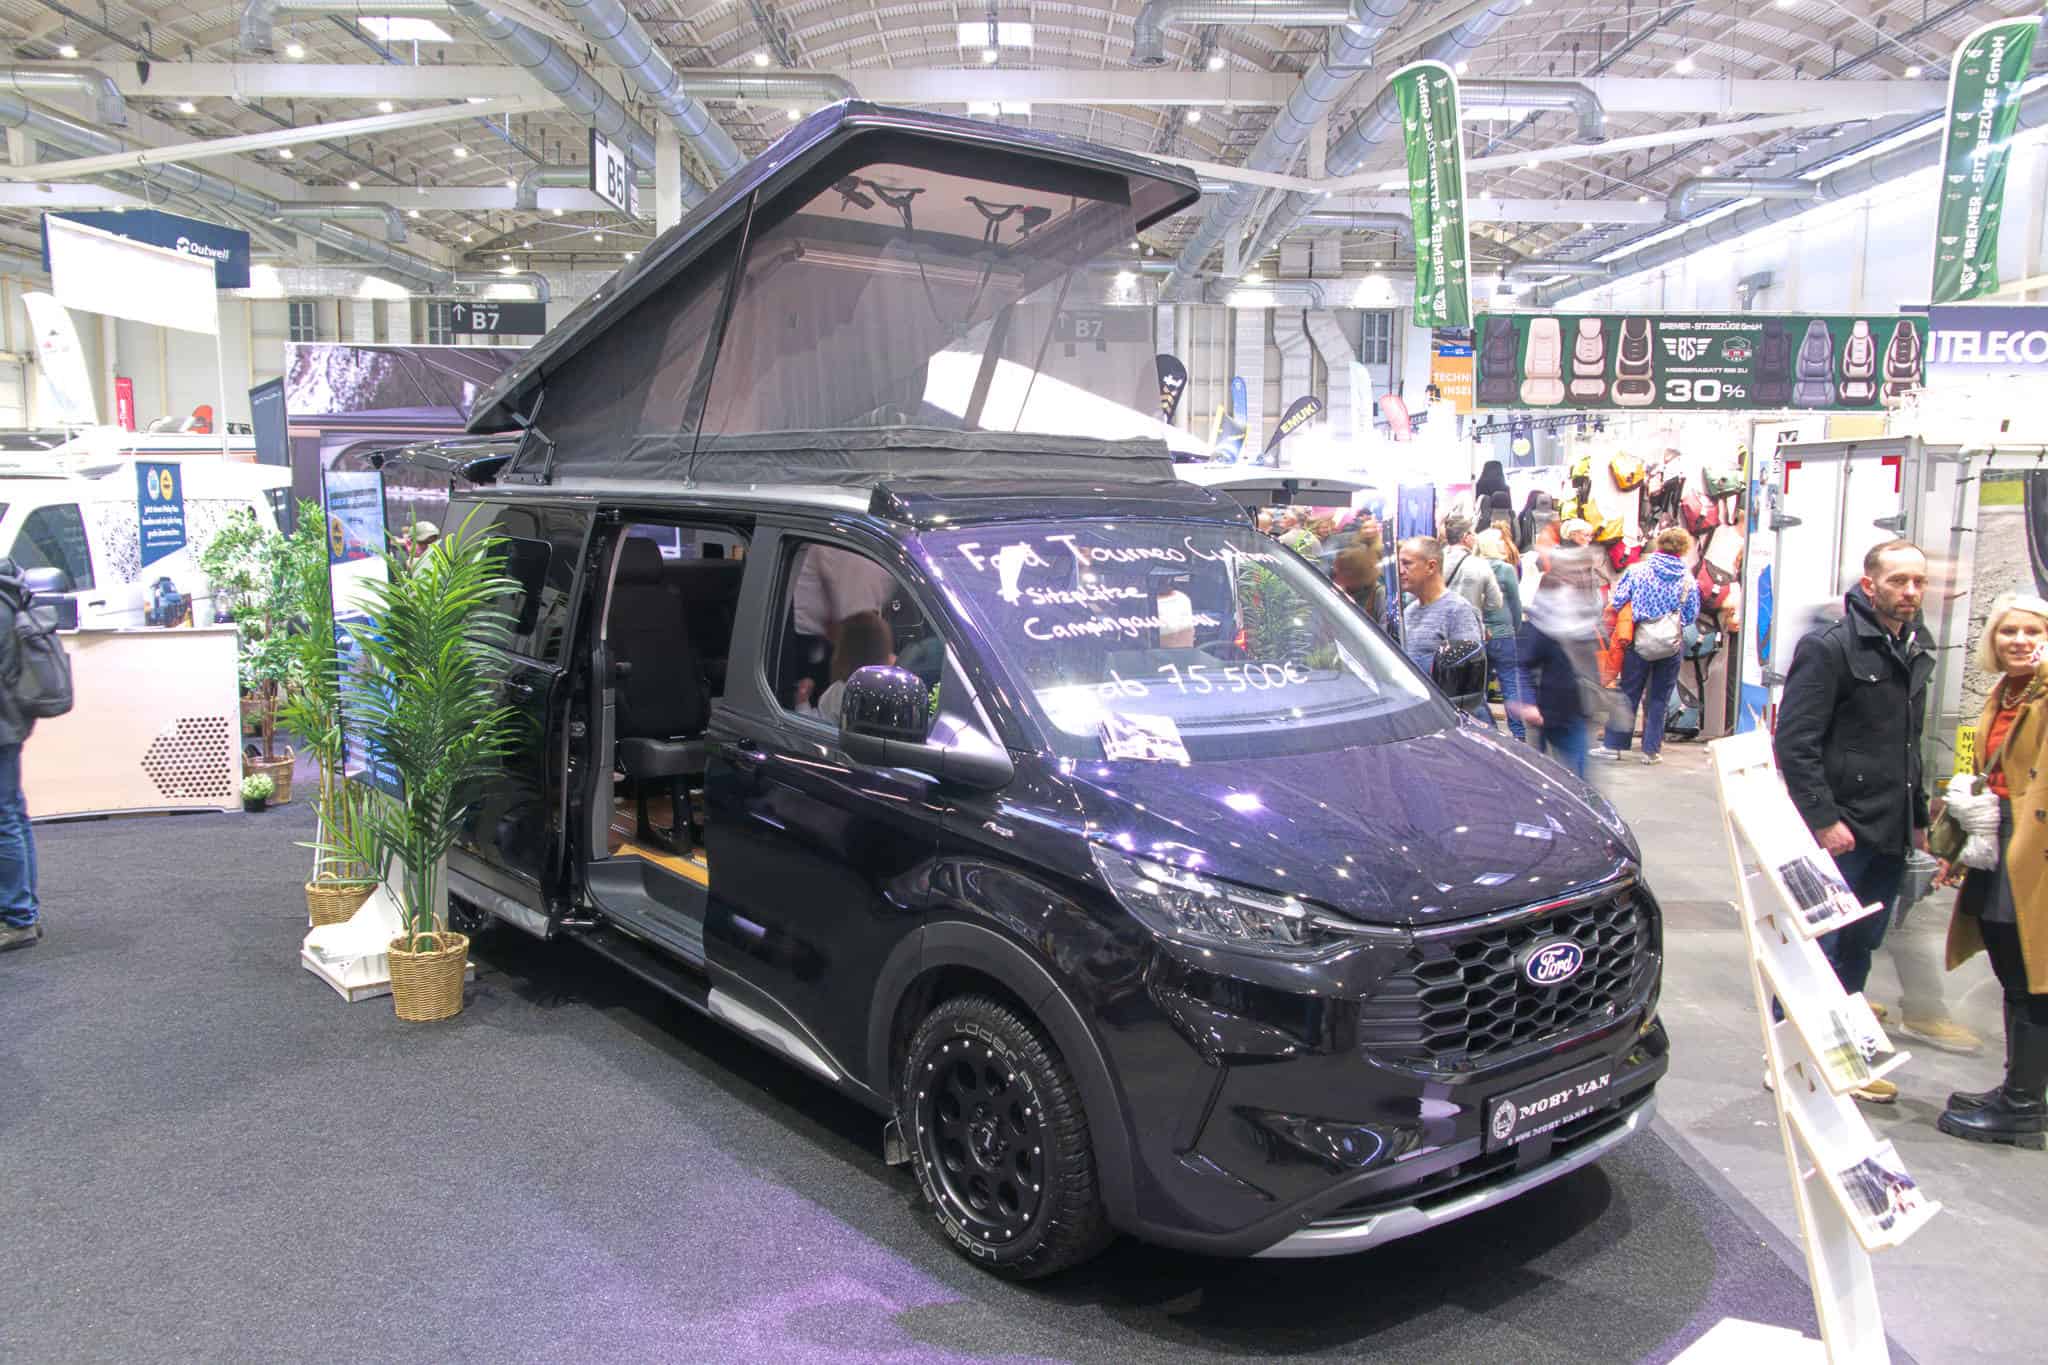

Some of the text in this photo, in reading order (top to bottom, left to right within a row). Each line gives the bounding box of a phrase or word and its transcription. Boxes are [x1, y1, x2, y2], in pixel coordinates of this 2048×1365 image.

[1963, 196, 1982, 259] BREMER
[1986, 36, 2006, 84] GmbH
[607, 154, 624, 205] B5
[190, 242, 229, 261] Outwell
[472, 311, 500, 330] B7
[1075, 320, 1104, 338] B7
[1665, 379, 1746, 402] 30%
[1045, 534, 1187, 567] Tourneo
[1025, 583, 1148, 608] Sitzplätze
[1098, 661, 1309, 697] ab 75.500€
[1537, 947, 1574, 980] Ford
[1519, 1088, 1574, 1120] MOBY
[1575, 1073, 1611, 1097] VAN
